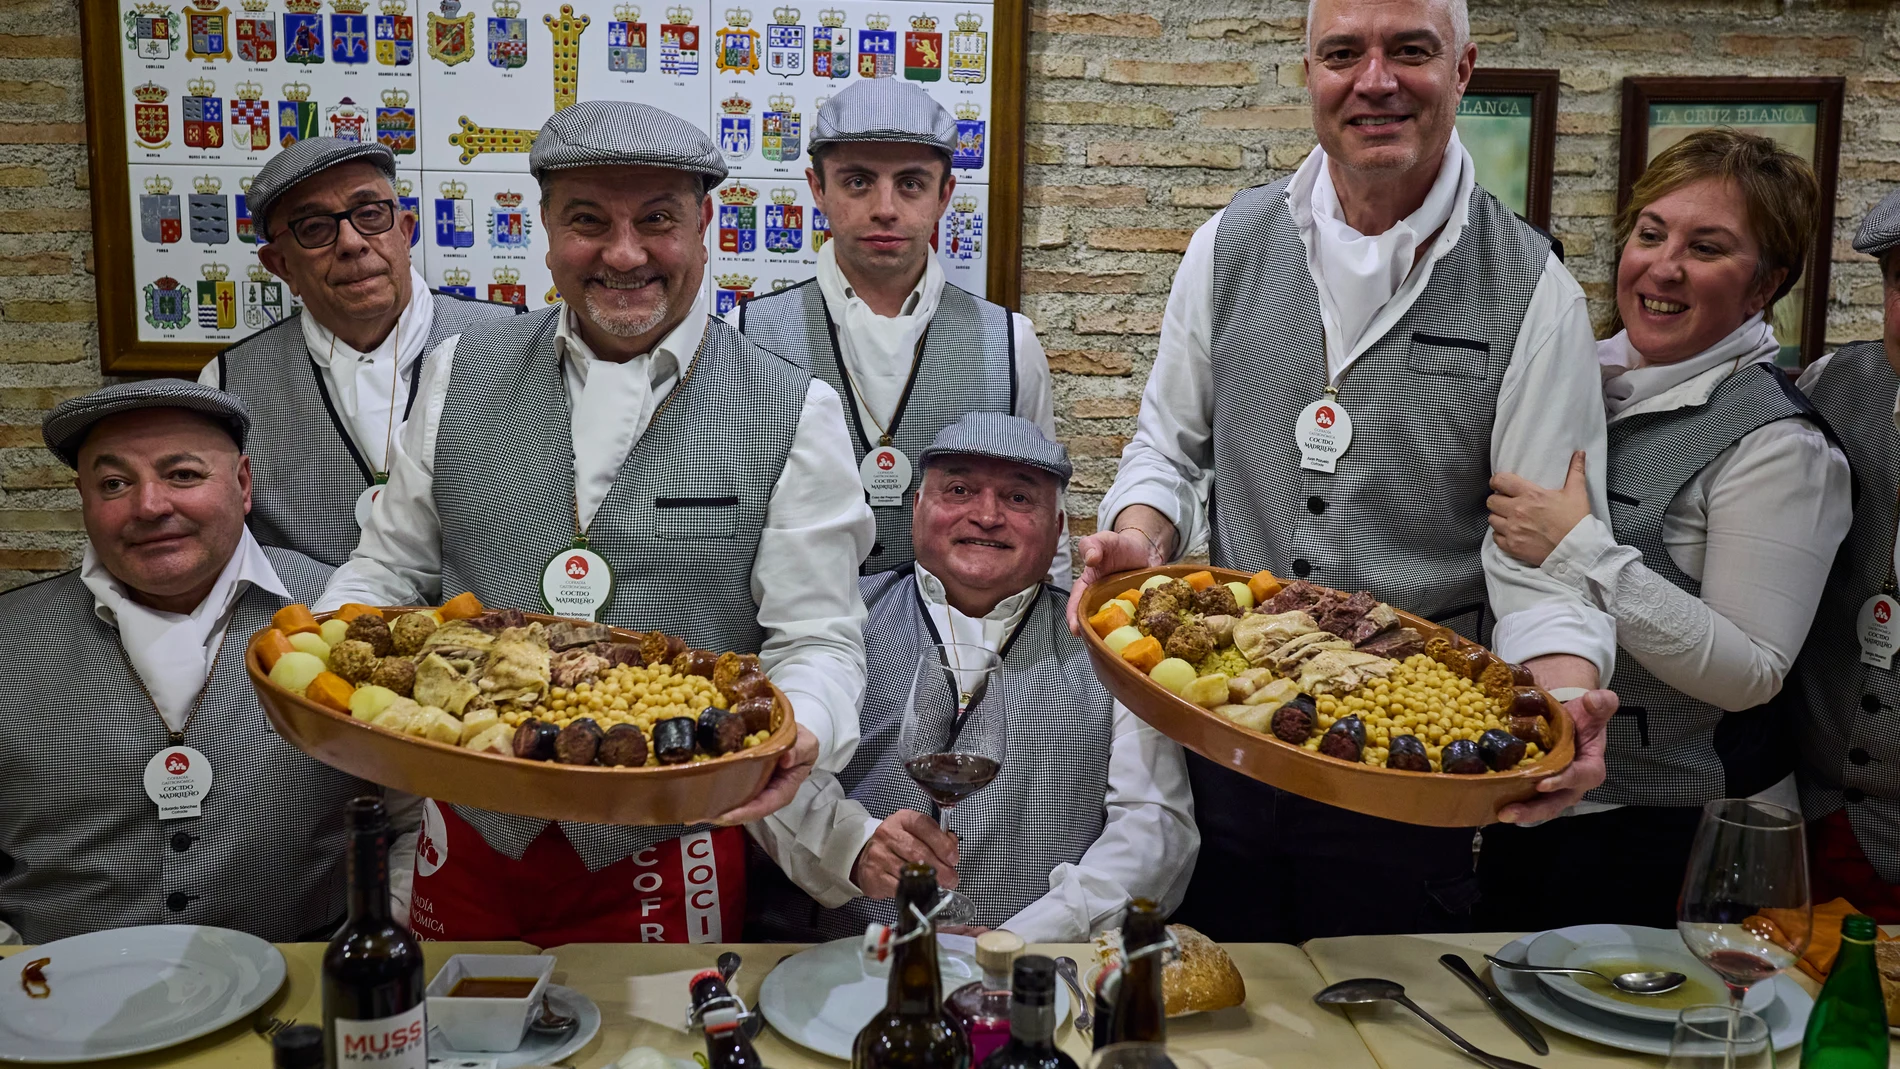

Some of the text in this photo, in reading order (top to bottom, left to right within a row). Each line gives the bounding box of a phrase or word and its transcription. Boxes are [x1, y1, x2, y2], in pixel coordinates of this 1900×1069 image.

[1656, 108, 1807, 123] LA CRUZ BLANCA
[1308, 436, 1334, 446] COCIDO
[1304, 442, 1337, 453] MADRILEÑO
[555, 596, 595, 605] MADRILEÑO
[1867, 631, 1890, 641] COCIDO
[163, 784, 194, 792] COCIDO
[158, 790, 200, 800] MADRILEÑO
[687, 839, 716, 943] COCI
[344, 1020, 421, 1053] MUSS
